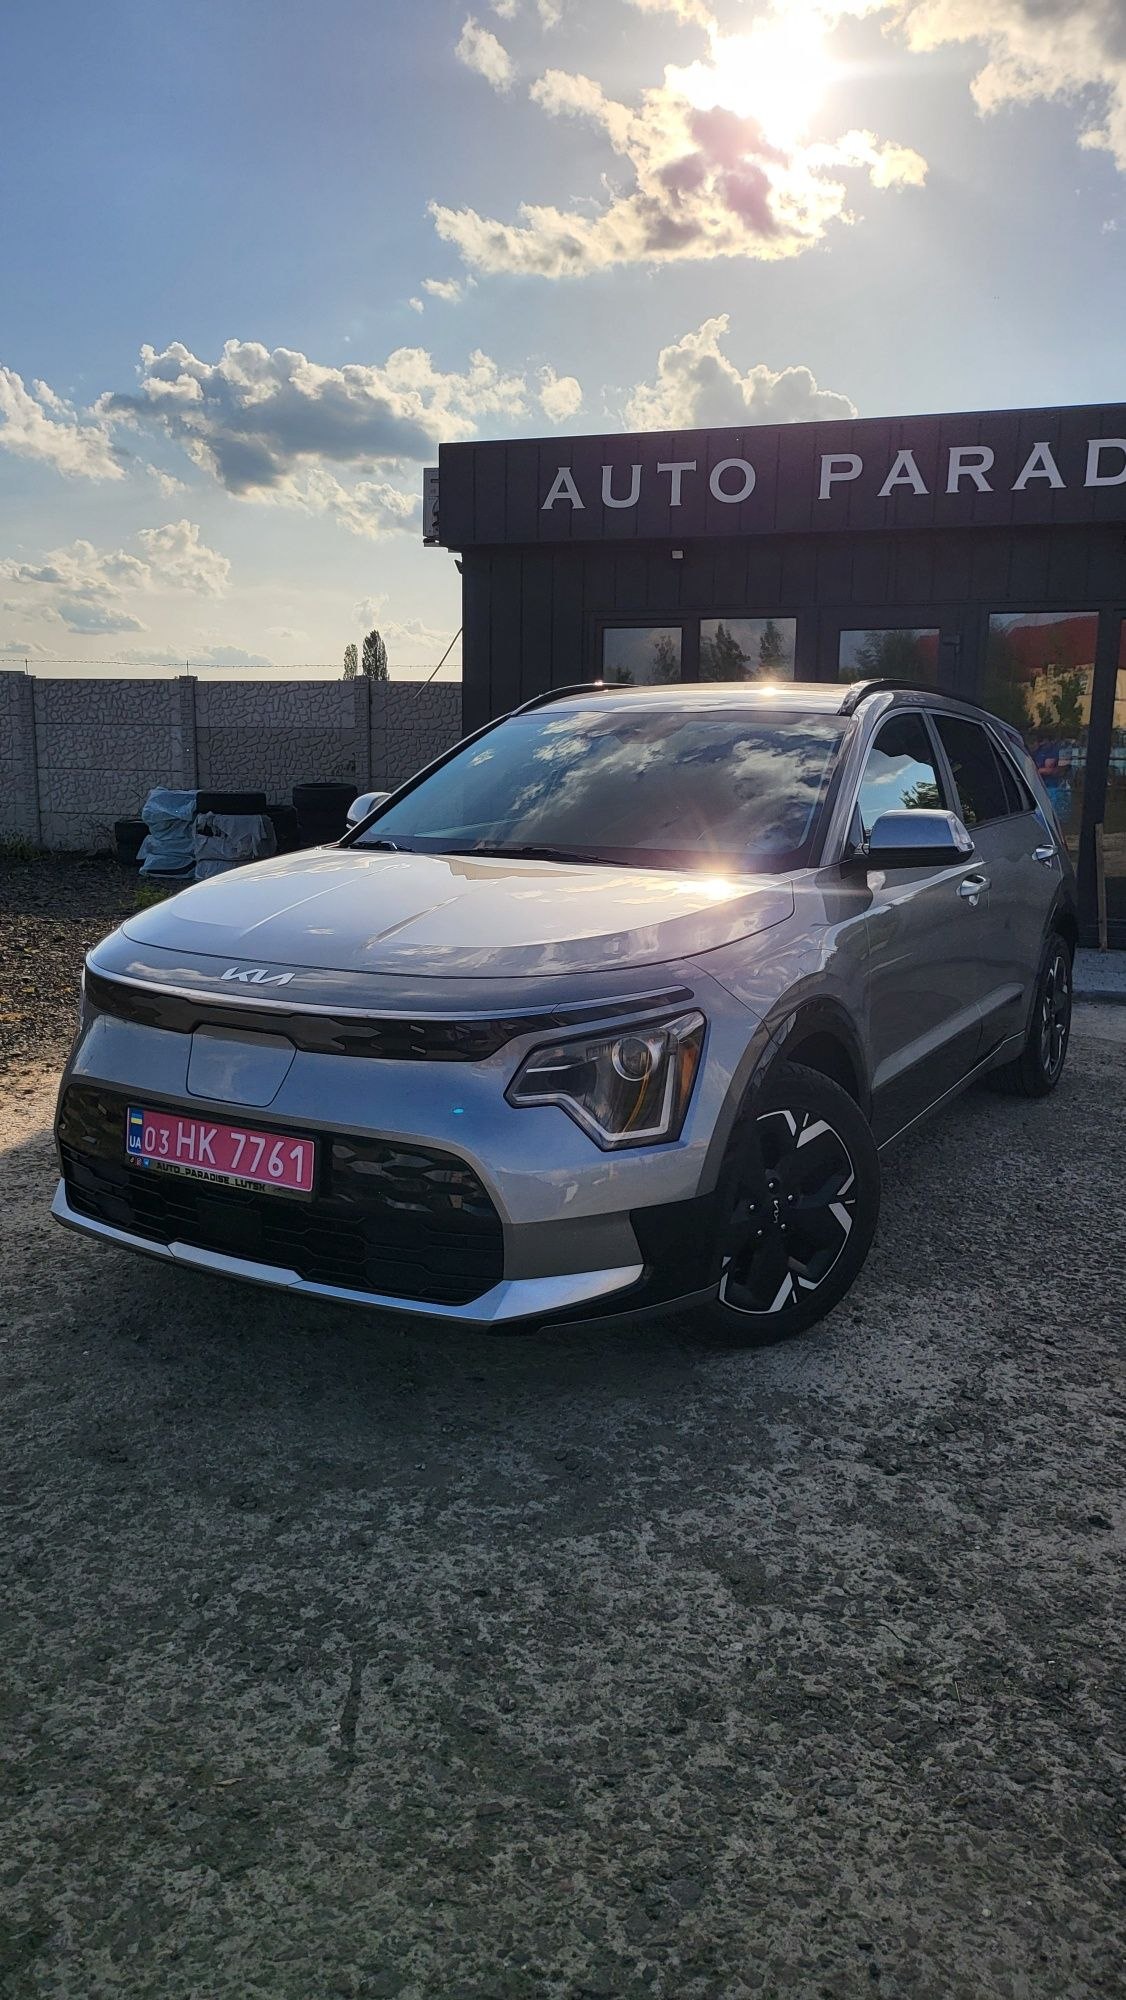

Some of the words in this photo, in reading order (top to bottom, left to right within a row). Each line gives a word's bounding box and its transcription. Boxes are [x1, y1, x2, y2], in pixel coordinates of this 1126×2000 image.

[541, 457, 757, 510] AUTO
[220, 967, 296, 986] KIA
[129, 1135, 142, 1149] UA
[144, 1126, 170, 1155] 03
[176, 1121, 218, 1165] HK
[229, 1132, 305, 1183] 7761
